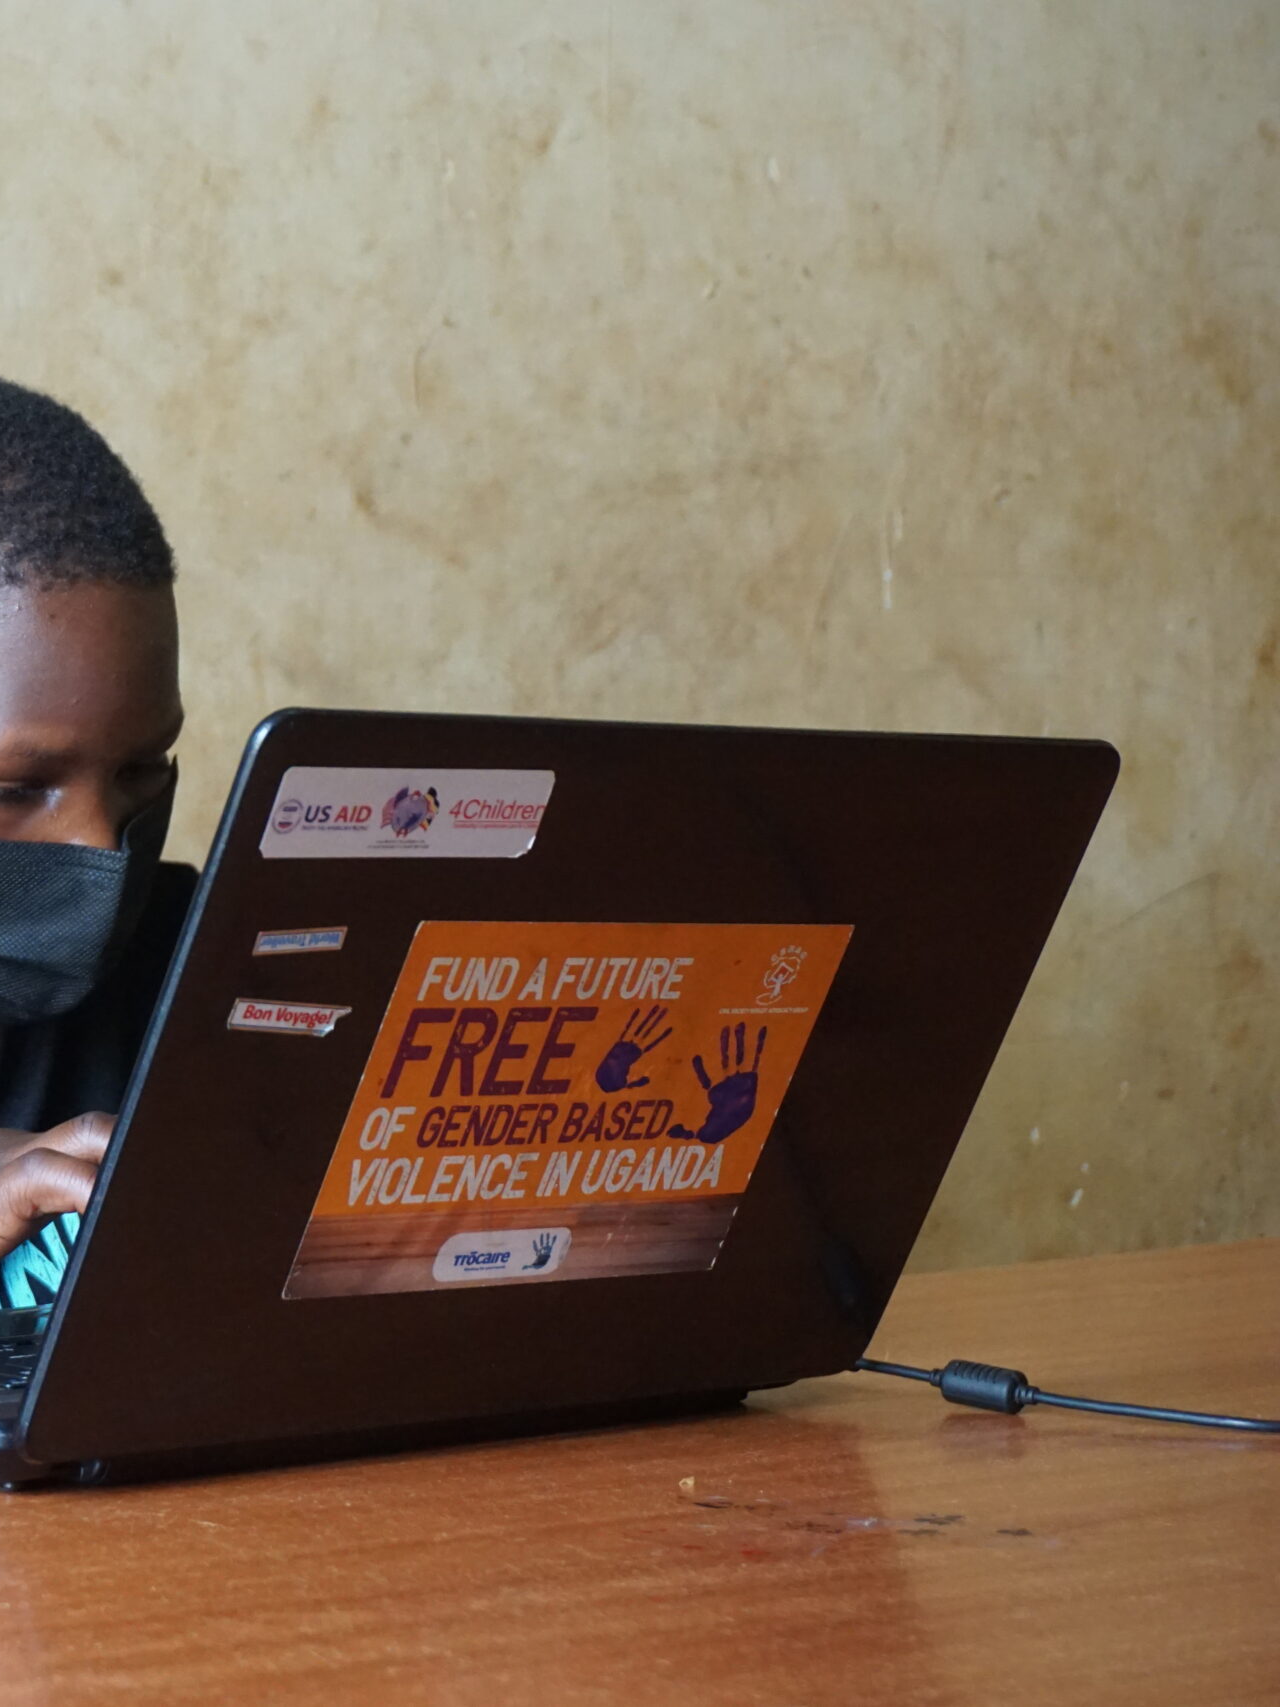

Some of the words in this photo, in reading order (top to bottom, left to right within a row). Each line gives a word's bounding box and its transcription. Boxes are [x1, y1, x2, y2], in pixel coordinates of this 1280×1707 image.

[417, 957, 518, 1001] FUND
[517, 958, 548, 1001] A
[551, 957, 693, 1000] FUTURE
[243, 1003, 273, 1021] Bon
[275, 1007, 334, 1028] Voyage!
[379, 1006, 598, 1099] FREE
[359, 1107, 416, 1151] OF
[416, 1103, 559, 1148] GENDER
[559, 1099, 675, 1144] BASED
[347, 1151, 540, 1207] VIOLENCE
[536, 1149, 583, 1197] IN
[580, 1145, 724, 1194] UGANDA
